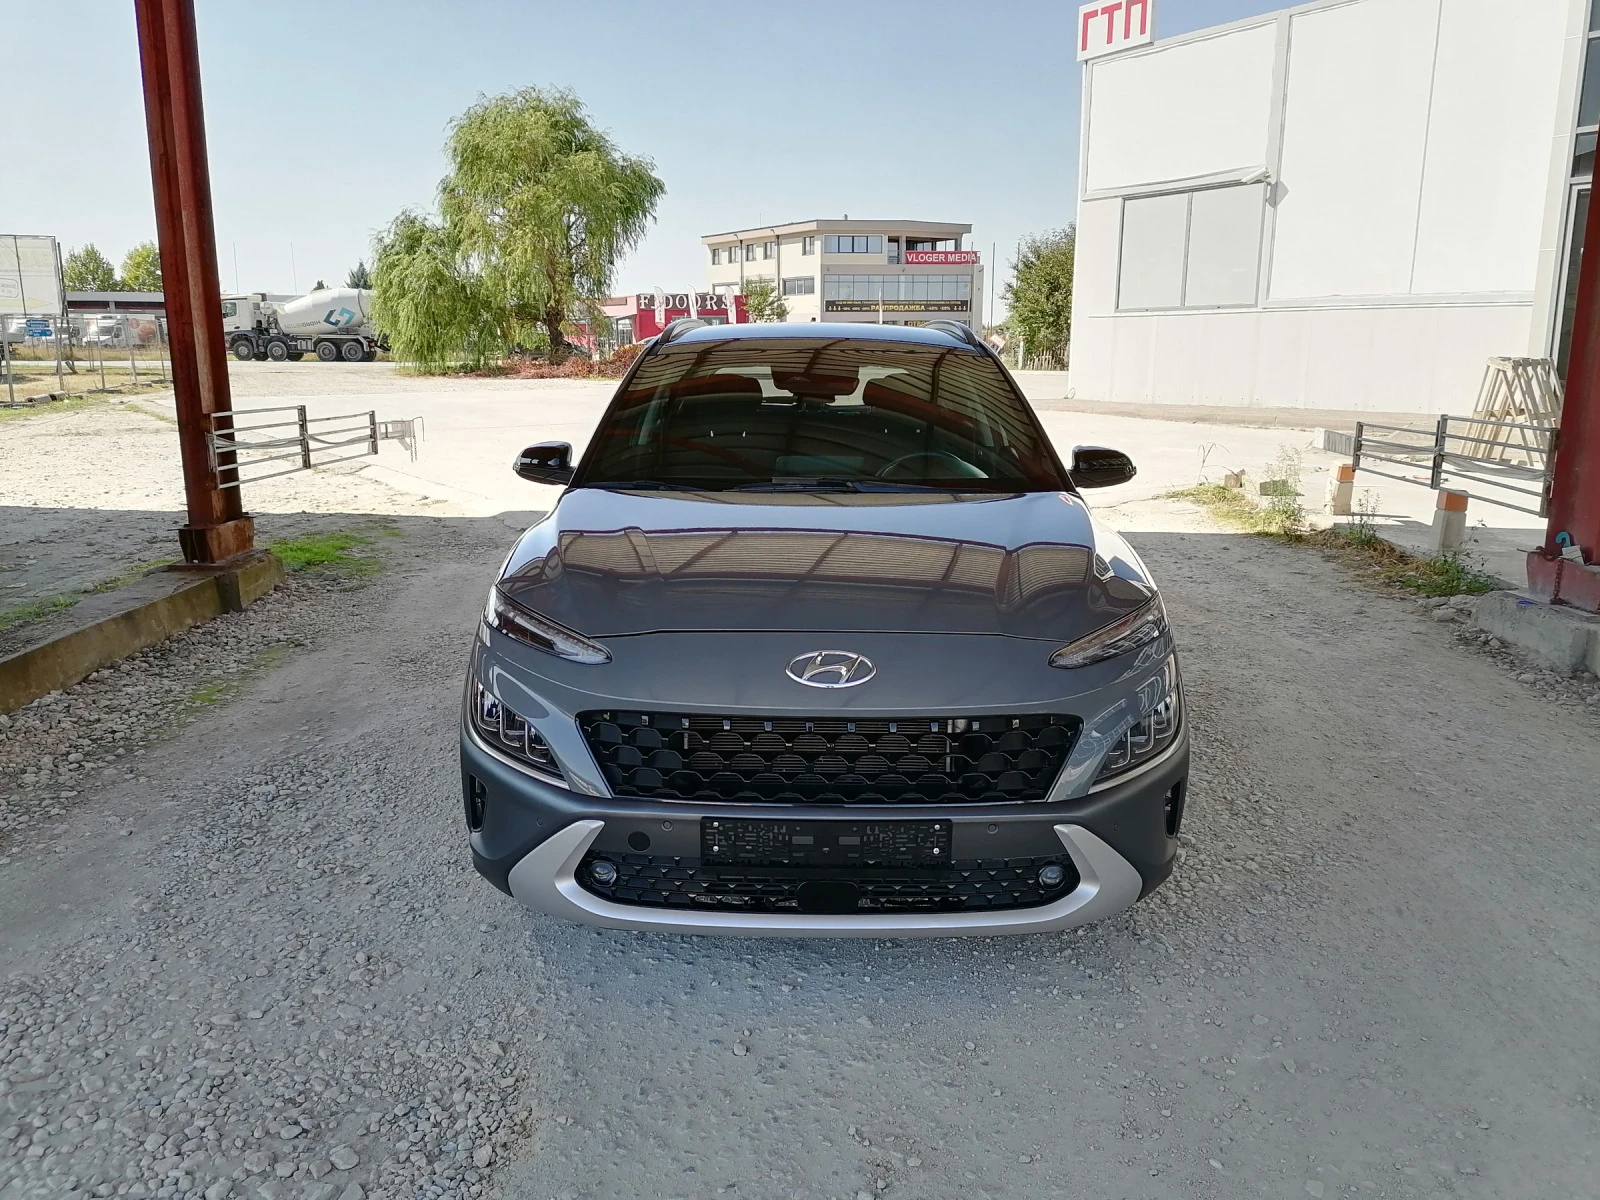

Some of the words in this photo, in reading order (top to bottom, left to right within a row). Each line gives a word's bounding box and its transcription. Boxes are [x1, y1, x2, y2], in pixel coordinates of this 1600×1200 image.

[1081, 0, 1148, 51] ГТП
[906, 253, 946, 262] VLOGER
[947, 253, 977, 262] MEDIA
[639, 294, 730, 310] FDORS
